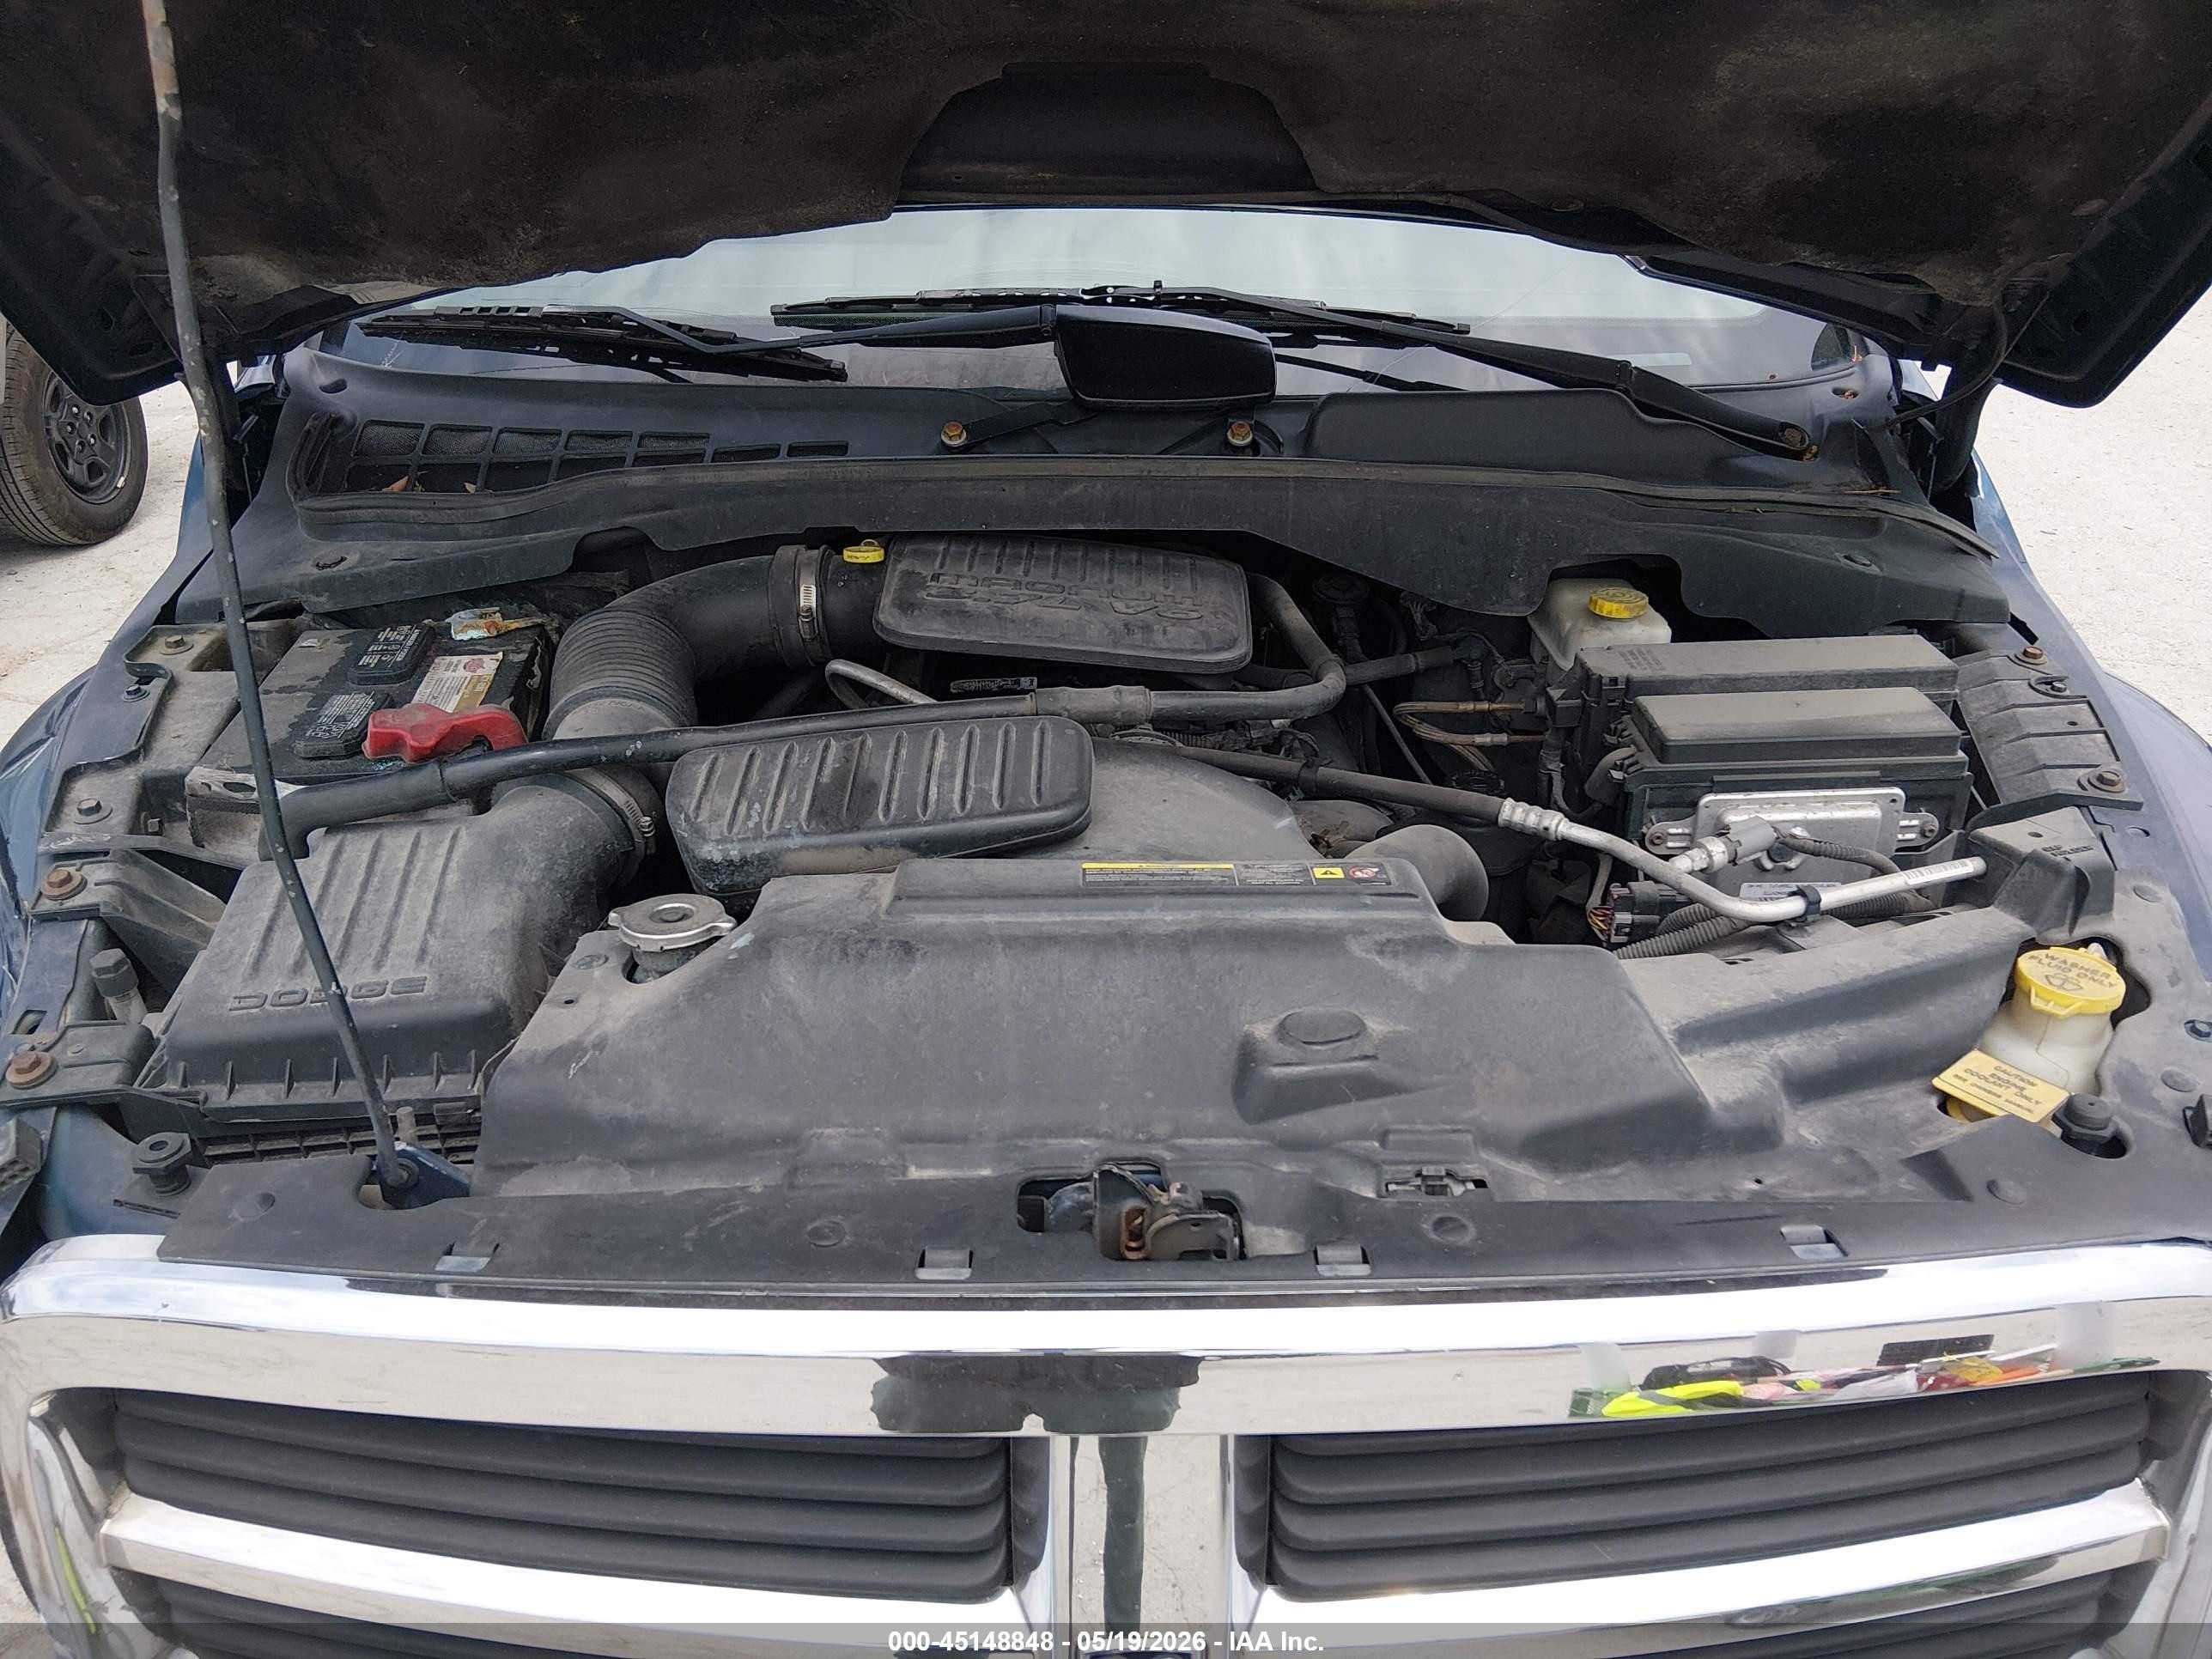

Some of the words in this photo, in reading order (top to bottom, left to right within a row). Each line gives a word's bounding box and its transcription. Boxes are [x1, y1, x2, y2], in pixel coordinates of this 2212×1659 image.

[2028, 955, 2072, 973] FLUID
[2076, 971, 2117, 988] ONLY
[2045, 953, 2111, 979] WASHER
[228, 975, 428, 1012] DODGE
[1964, 1067, 2012, 1091] COOLANT
[2014, 1091, 2043, 1106] ONLY
[1989, 1073, 2027, 1091] ENGINE
[1993, 1065, 2039, 1087] CAUTION
